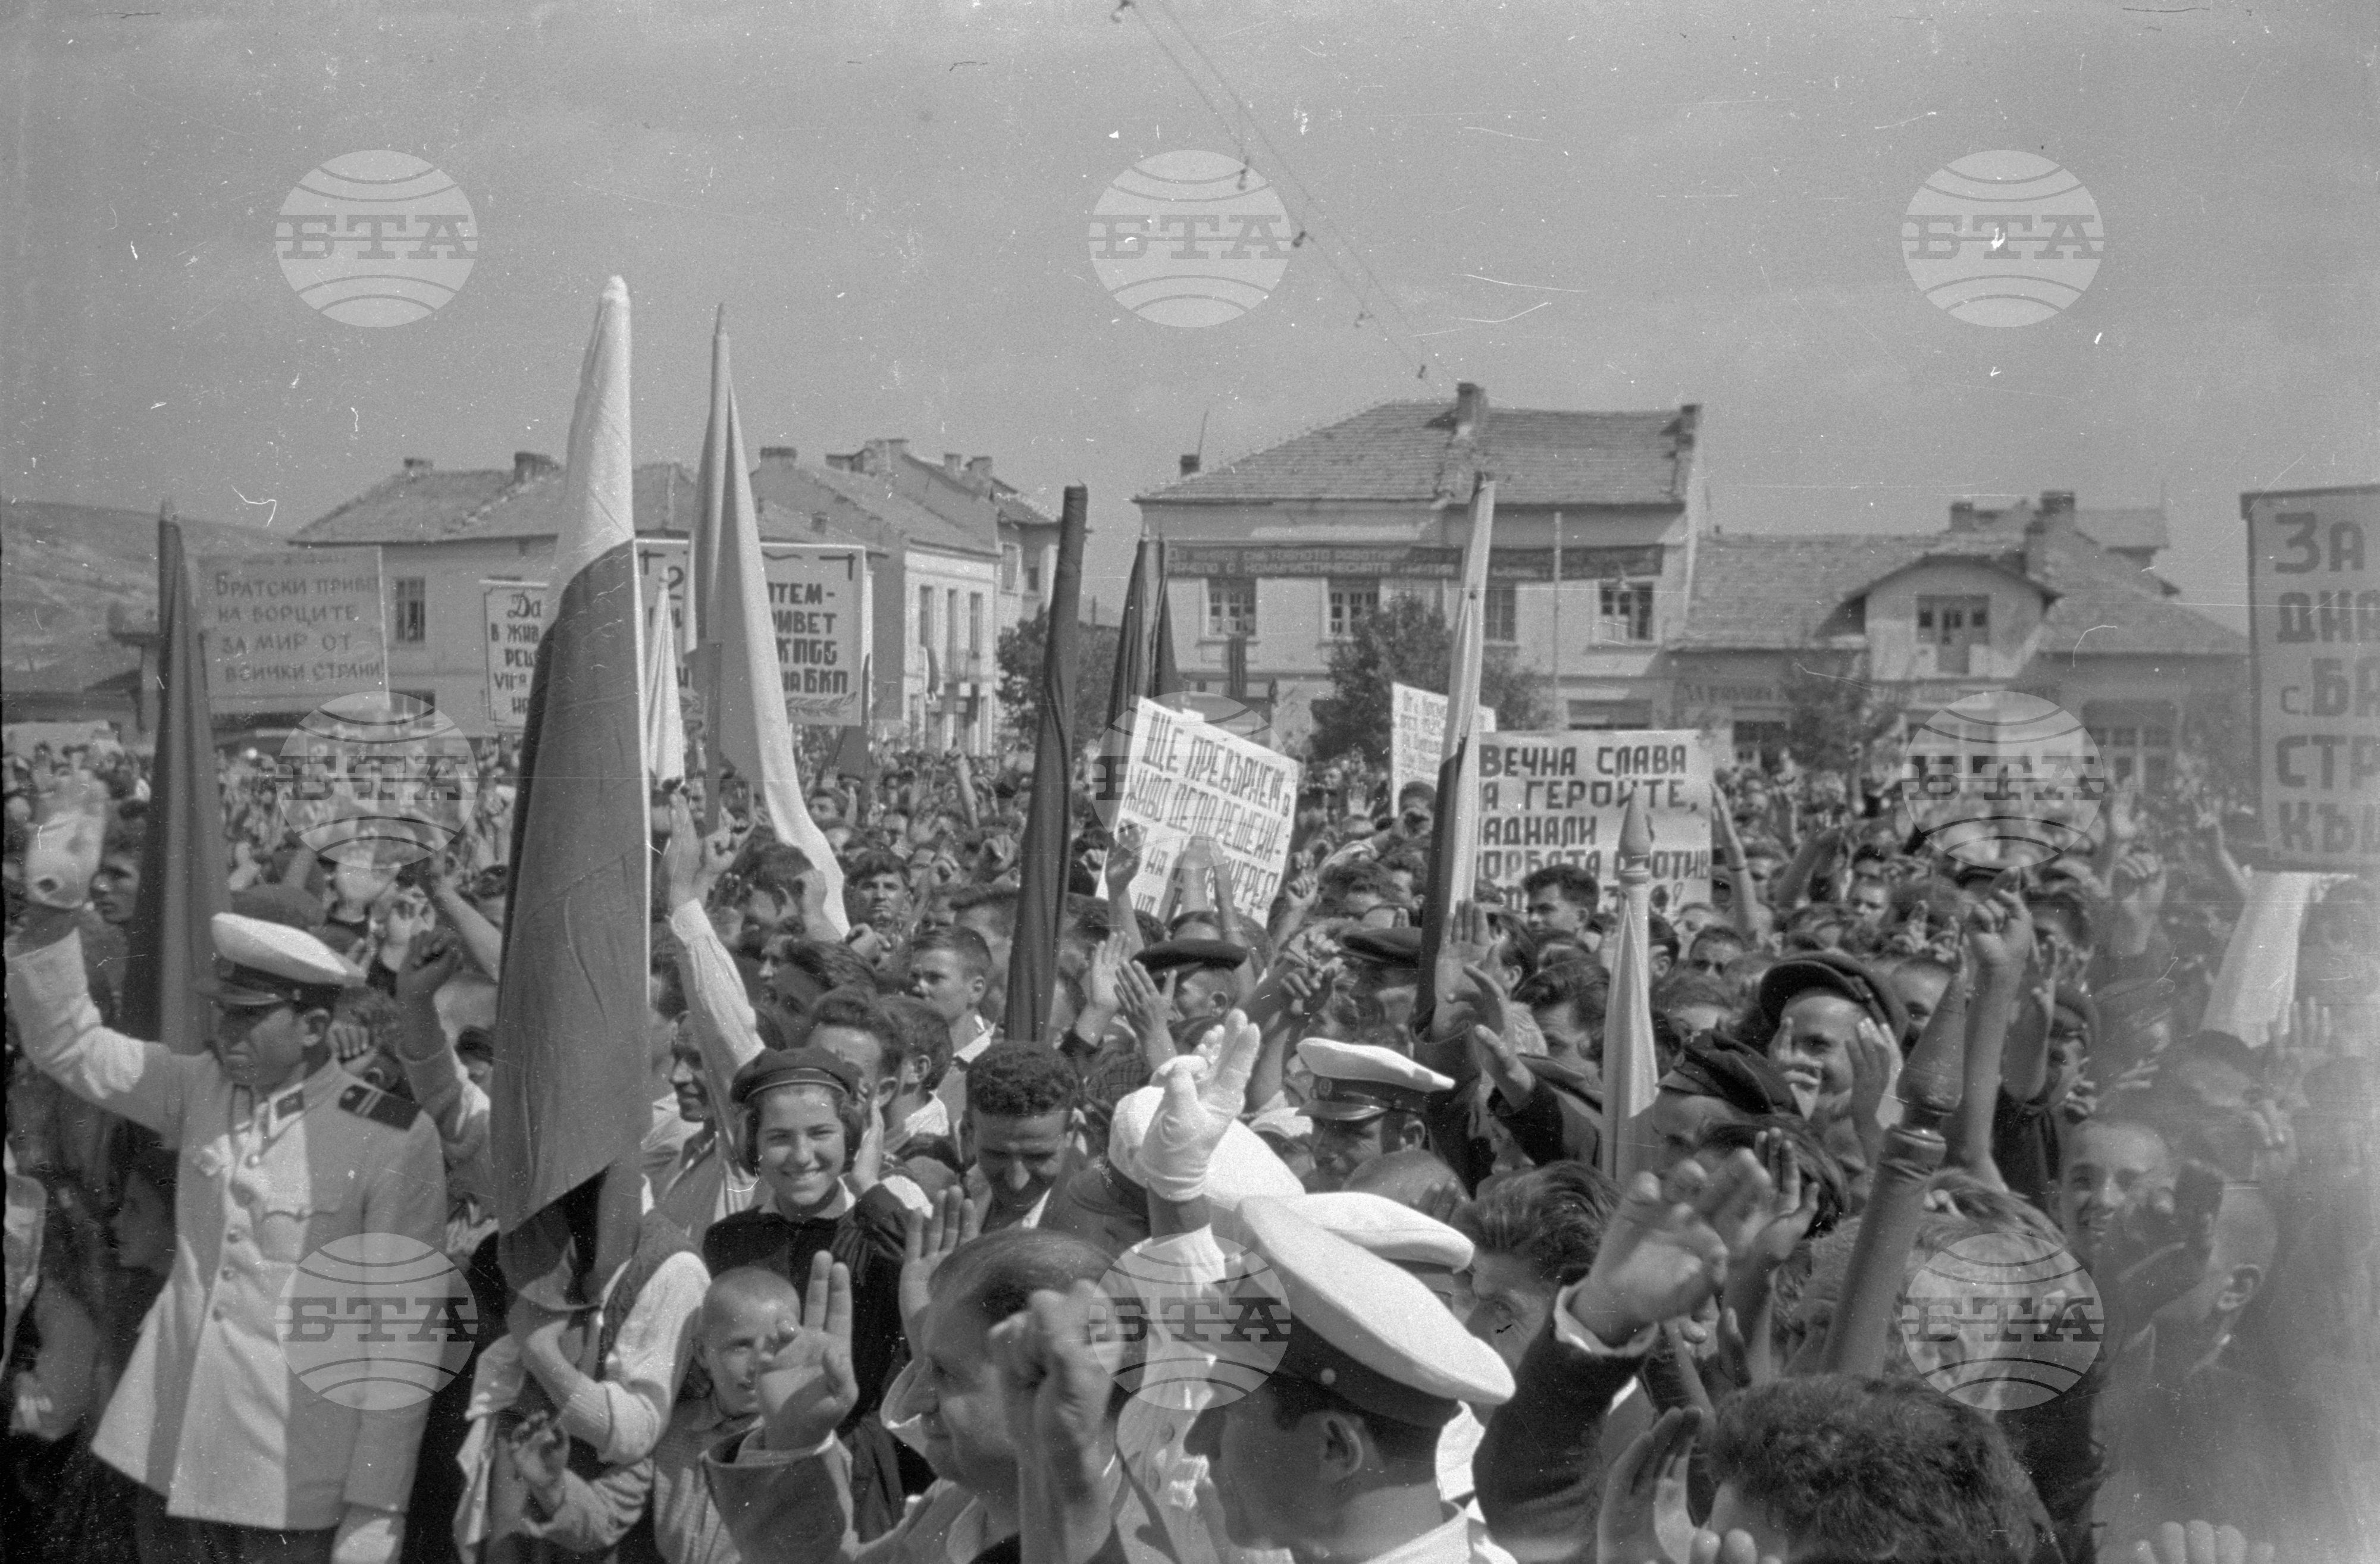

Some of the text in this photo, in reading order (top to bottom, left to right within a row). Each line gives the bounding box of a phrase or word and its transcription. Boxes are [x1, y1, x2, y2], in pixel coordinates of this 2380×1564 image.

[2275, 512, 2365, 574] ЗА
[214, 570, 307, 598] БРАТСКИ
[218, 604, 358, 626] НА БОРЦИТЕ
[221, 634, 352, 654] ЗА МИР ОТ
[226, 663, 305, 683] ВСИЧКИ
[804, 667, 848, 694] БКП
[1142, 710, 1184, 772] ЩЕ
[1184, 735, 1285, 813] ПРЕВЪРНЕМ
[1479, 744, 1687, 777] ВЕЧНА СЛАВА
[1479, 781, 1499, 811] А
[1477, 816, 1598, 848] АДНАЛИ
